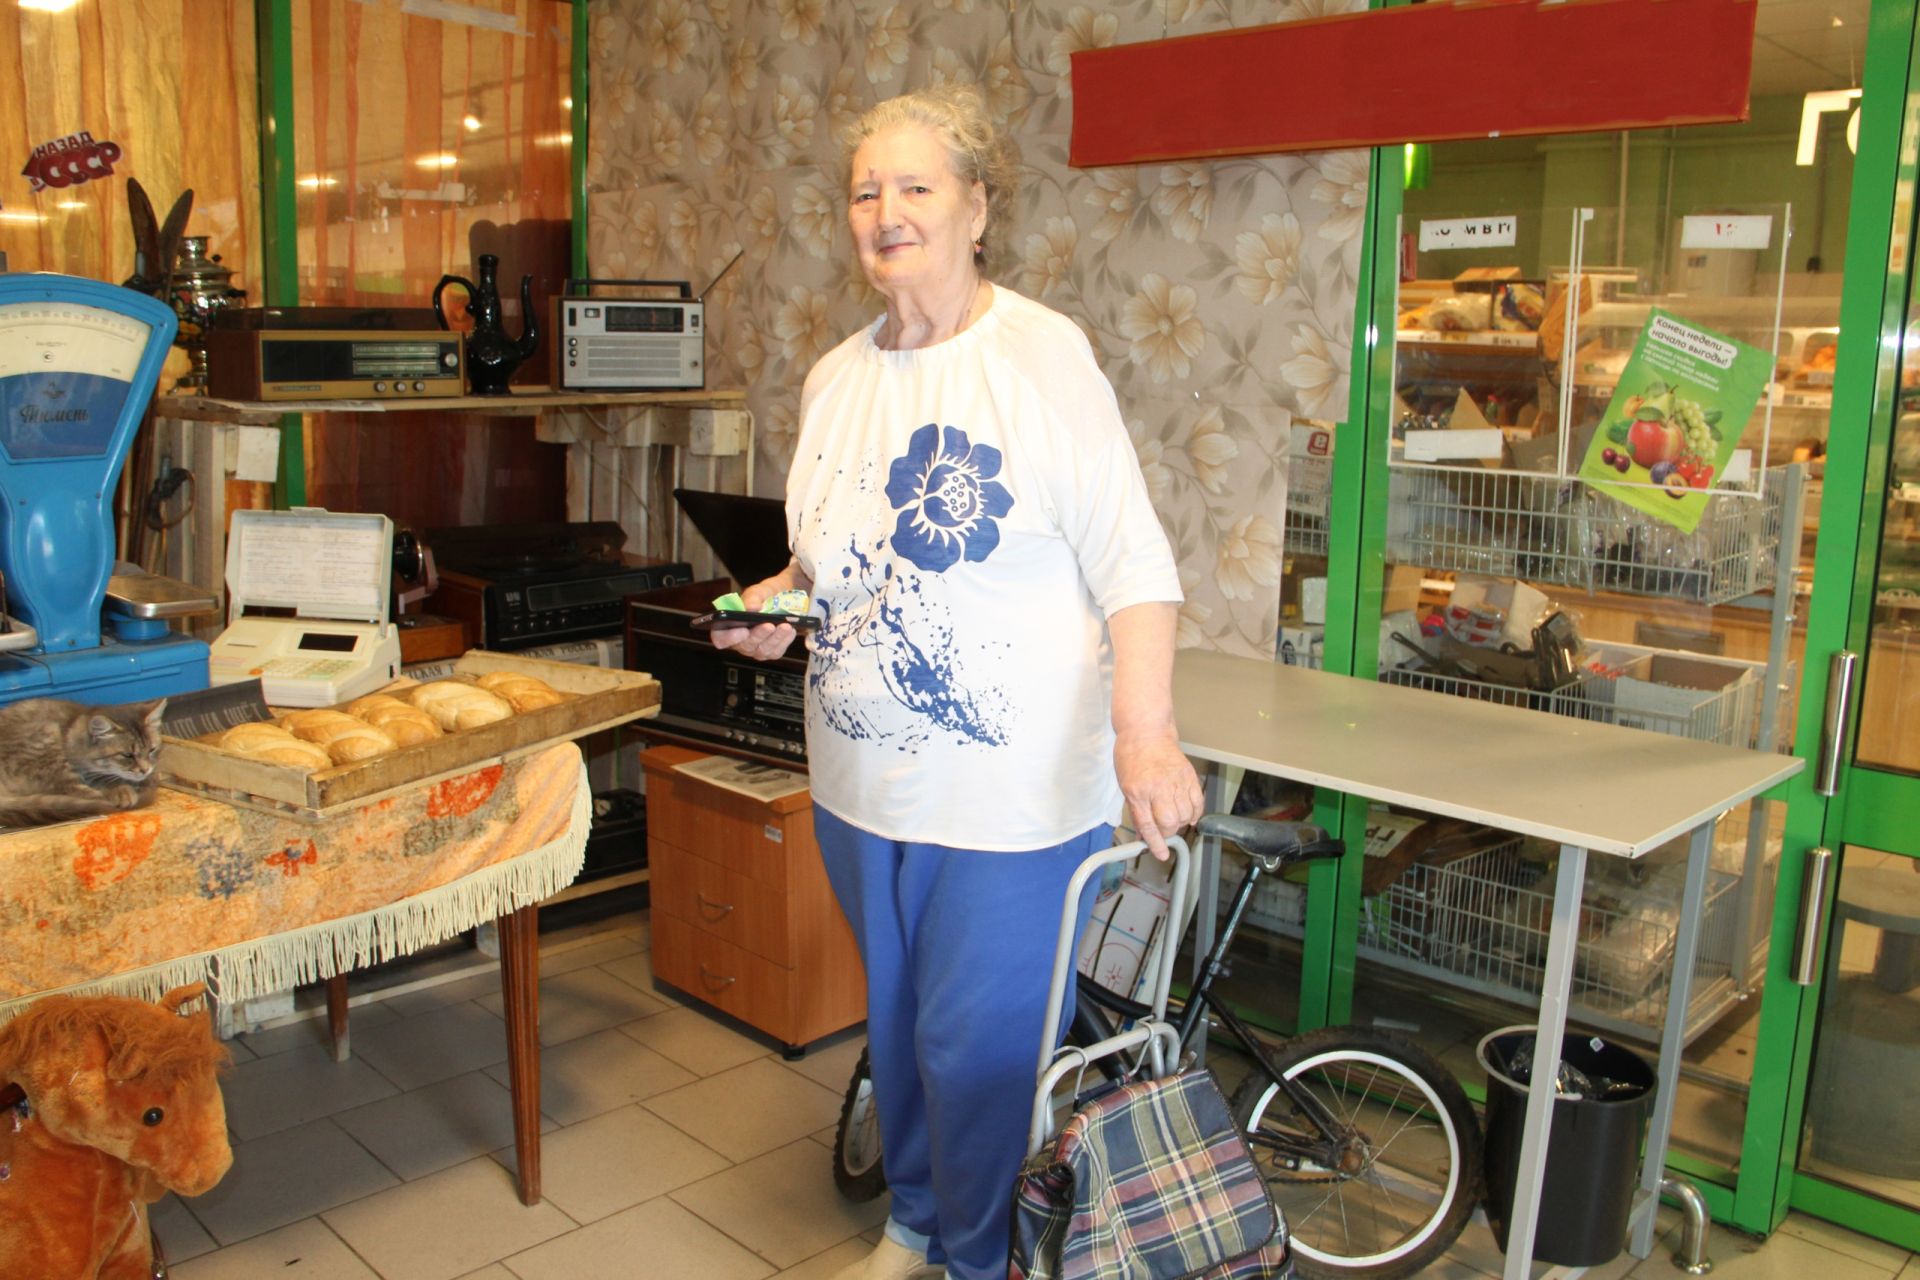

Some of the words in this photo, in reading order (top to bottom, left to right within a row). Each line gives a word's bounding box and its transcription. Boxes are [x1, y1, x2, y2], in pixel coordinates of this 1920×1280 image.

[32, 131, 96, 159] НАЗАД
[1651, 329, 1687, 348] начало
[1688, 345, 1729, 366] выгоды!
[1656, 318, 1686, 337] Конец
[1687, 332, 1722, 351] недели
